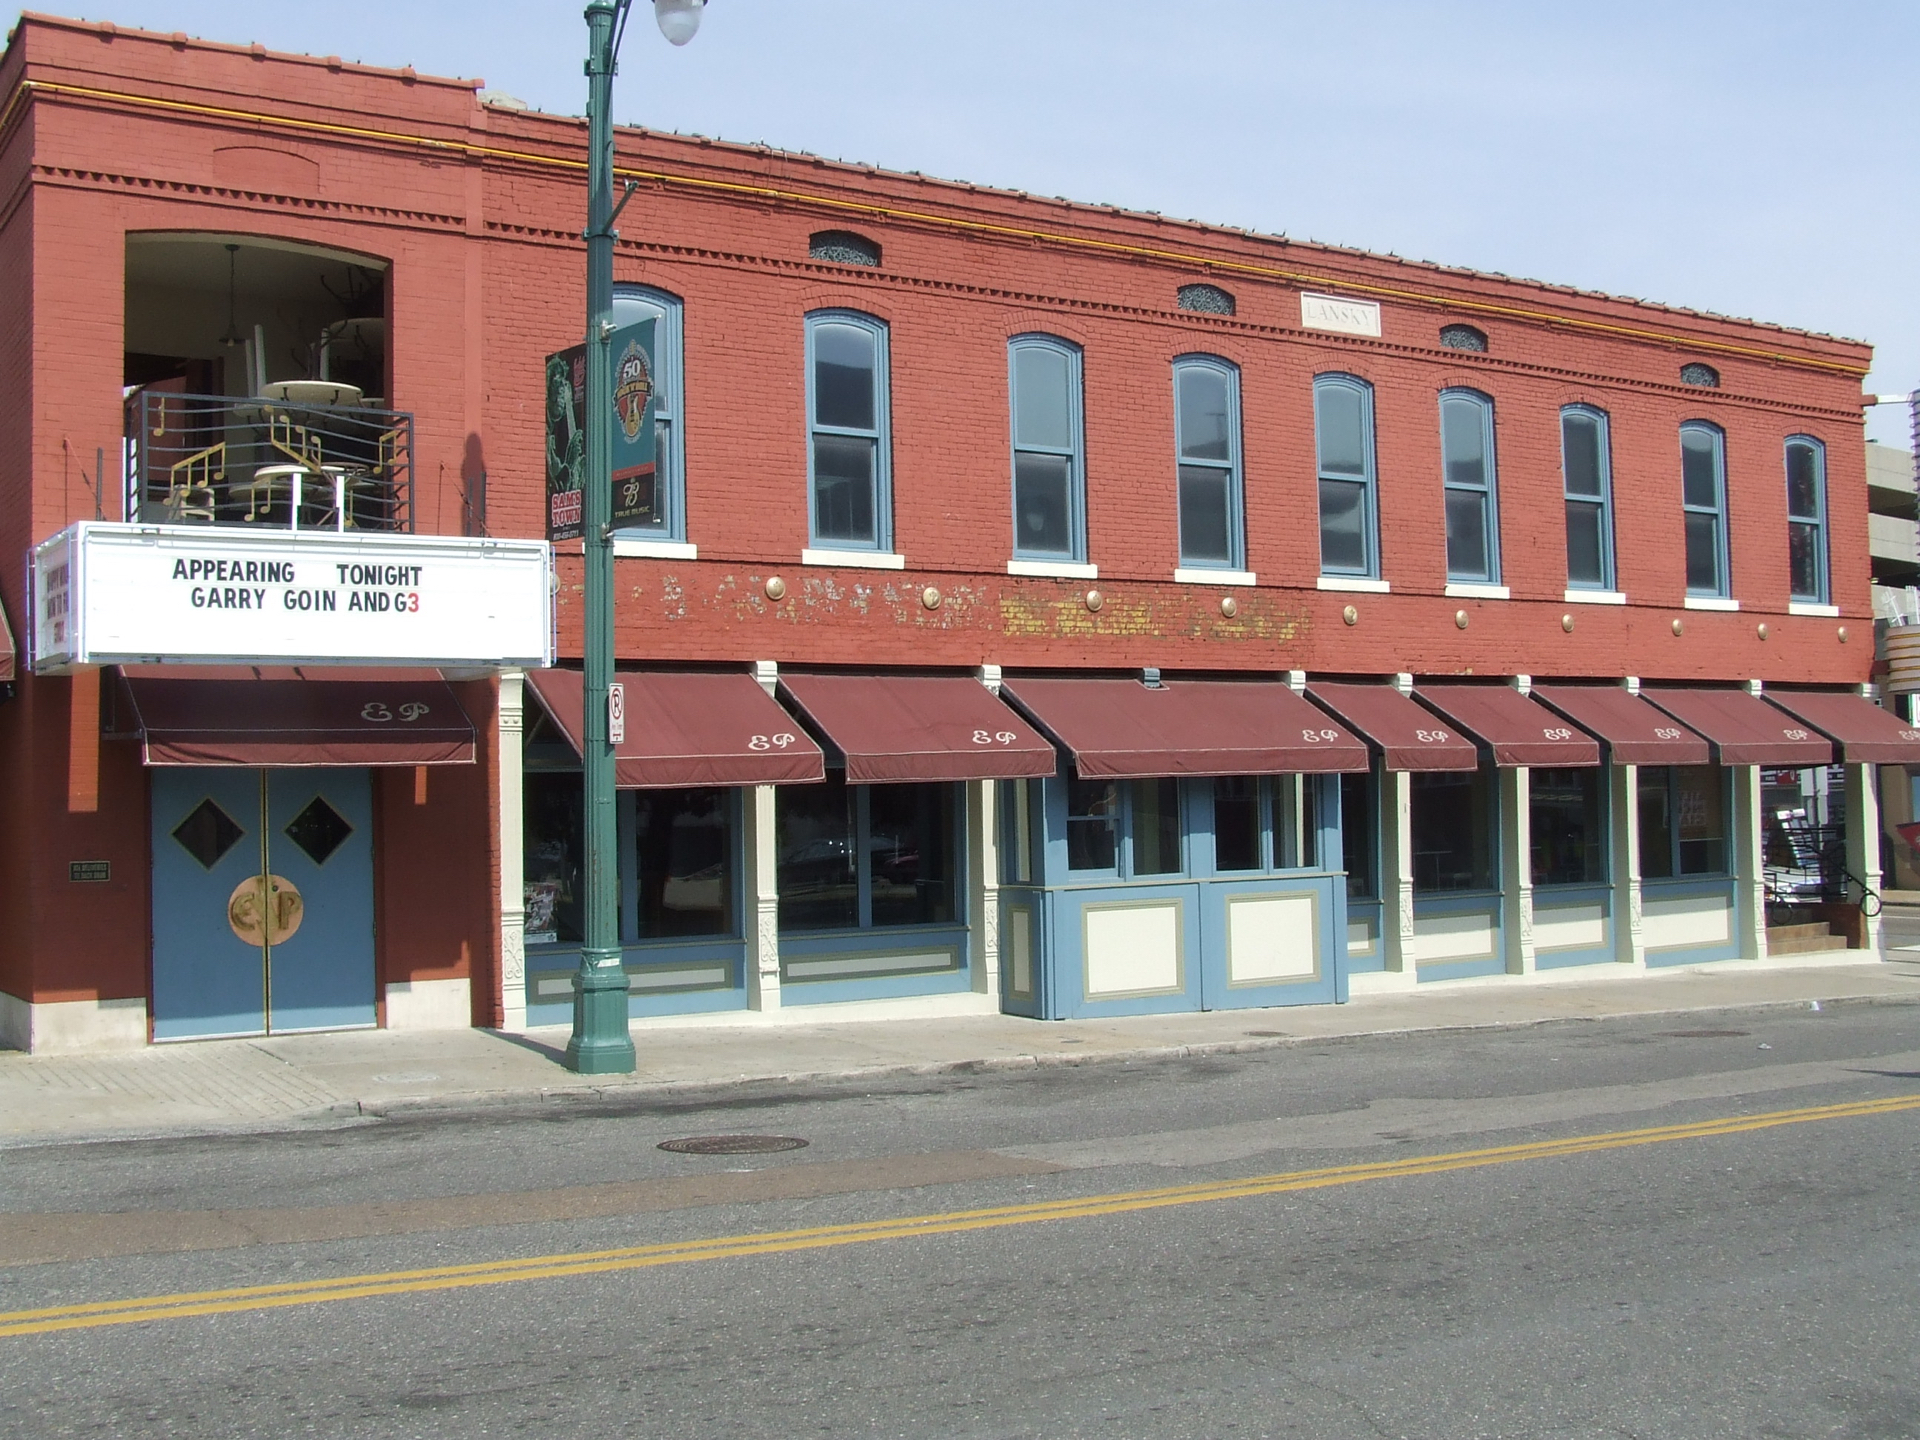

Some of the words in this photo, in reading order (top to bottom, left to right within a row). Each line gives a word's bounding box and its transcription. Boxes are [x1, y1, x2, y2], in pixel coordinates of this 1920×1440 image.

[1307, 302, 1373, 326] LANSKY
[623, 360, 641, 378] 50
[552, 506, 582, 527] TOWN
[614, 509, 630, 519] TRUE
[631, 505, 651, 515] MUSIC
[172, 558, 295, 583] APPEARING
[336, 563, 423, 586] TONIGHT
[191, 587, 266, 609] GARRY
[283, 589, 336, 611] GOIN
